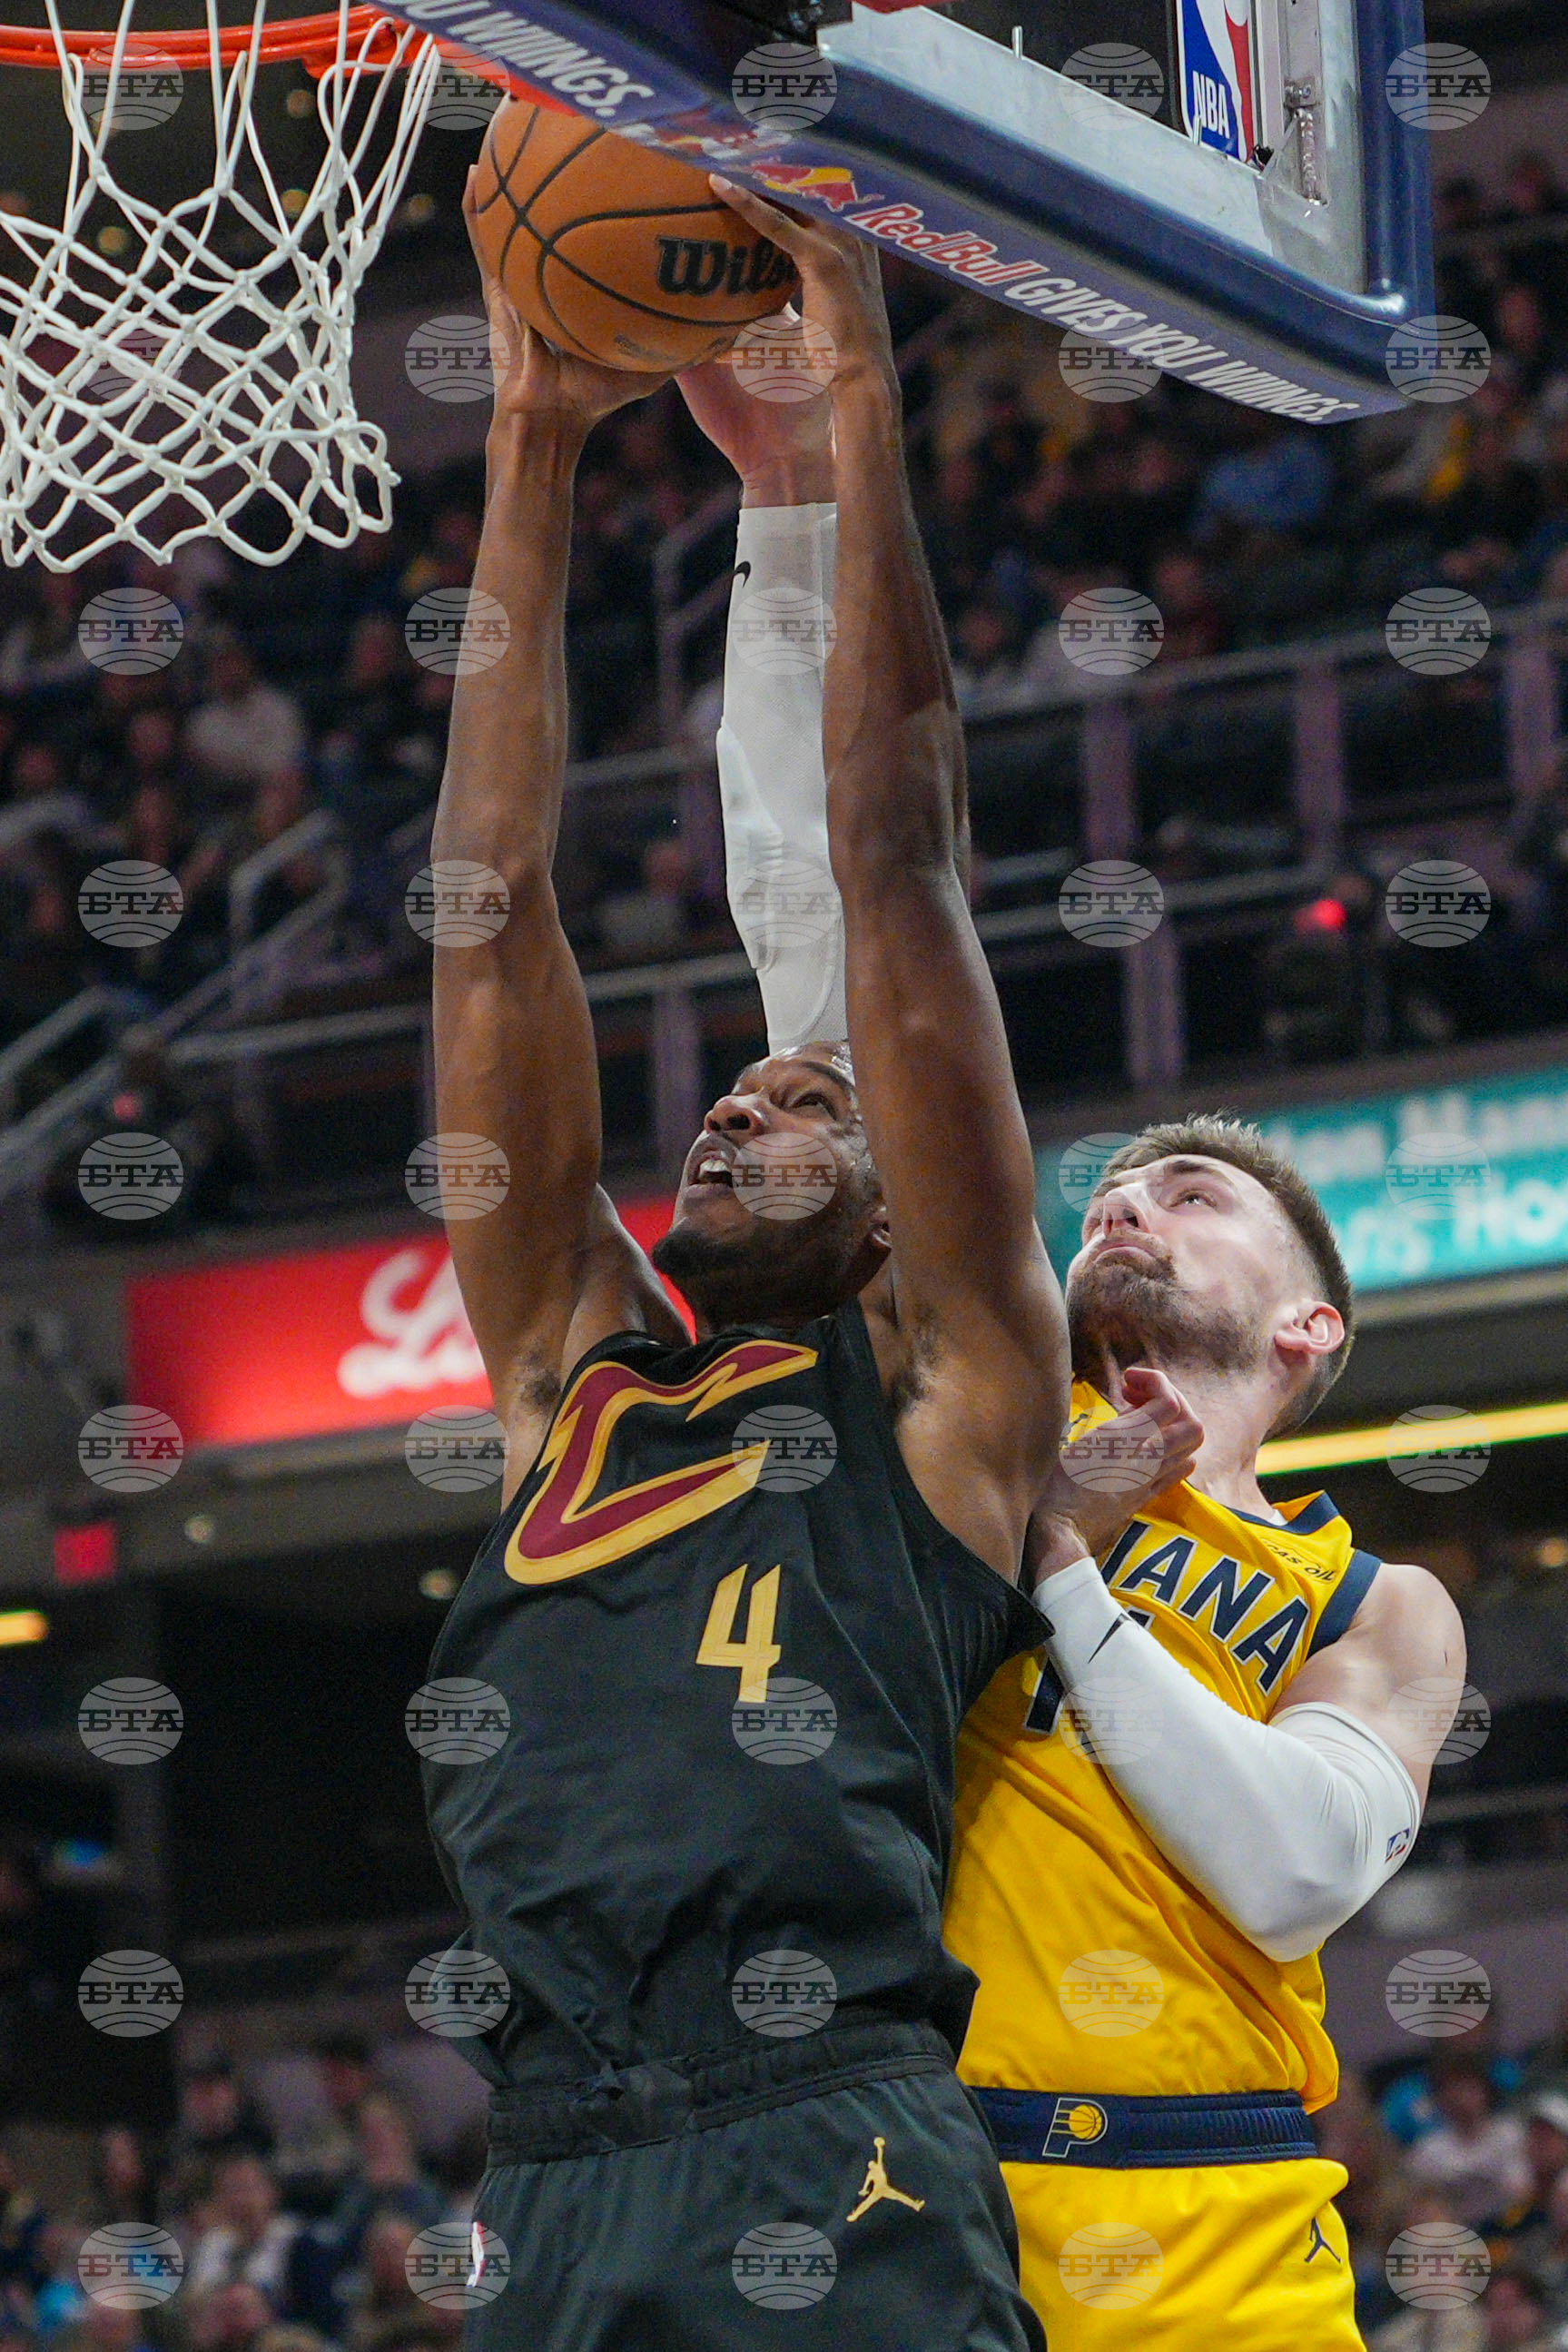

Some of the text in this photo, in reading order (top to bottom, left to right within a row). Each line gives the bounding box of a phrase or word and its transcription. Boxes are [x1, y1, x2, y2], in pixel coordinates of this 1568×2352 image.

[1192, 70, 1230, 139] NBA
[1005, 278, 1149, 332] GIVES
[1108, 322, 1228, 369] YOU
[695, 1564, 782, 1704] 4
[1099, 1519, 1311, 1697] IANA
